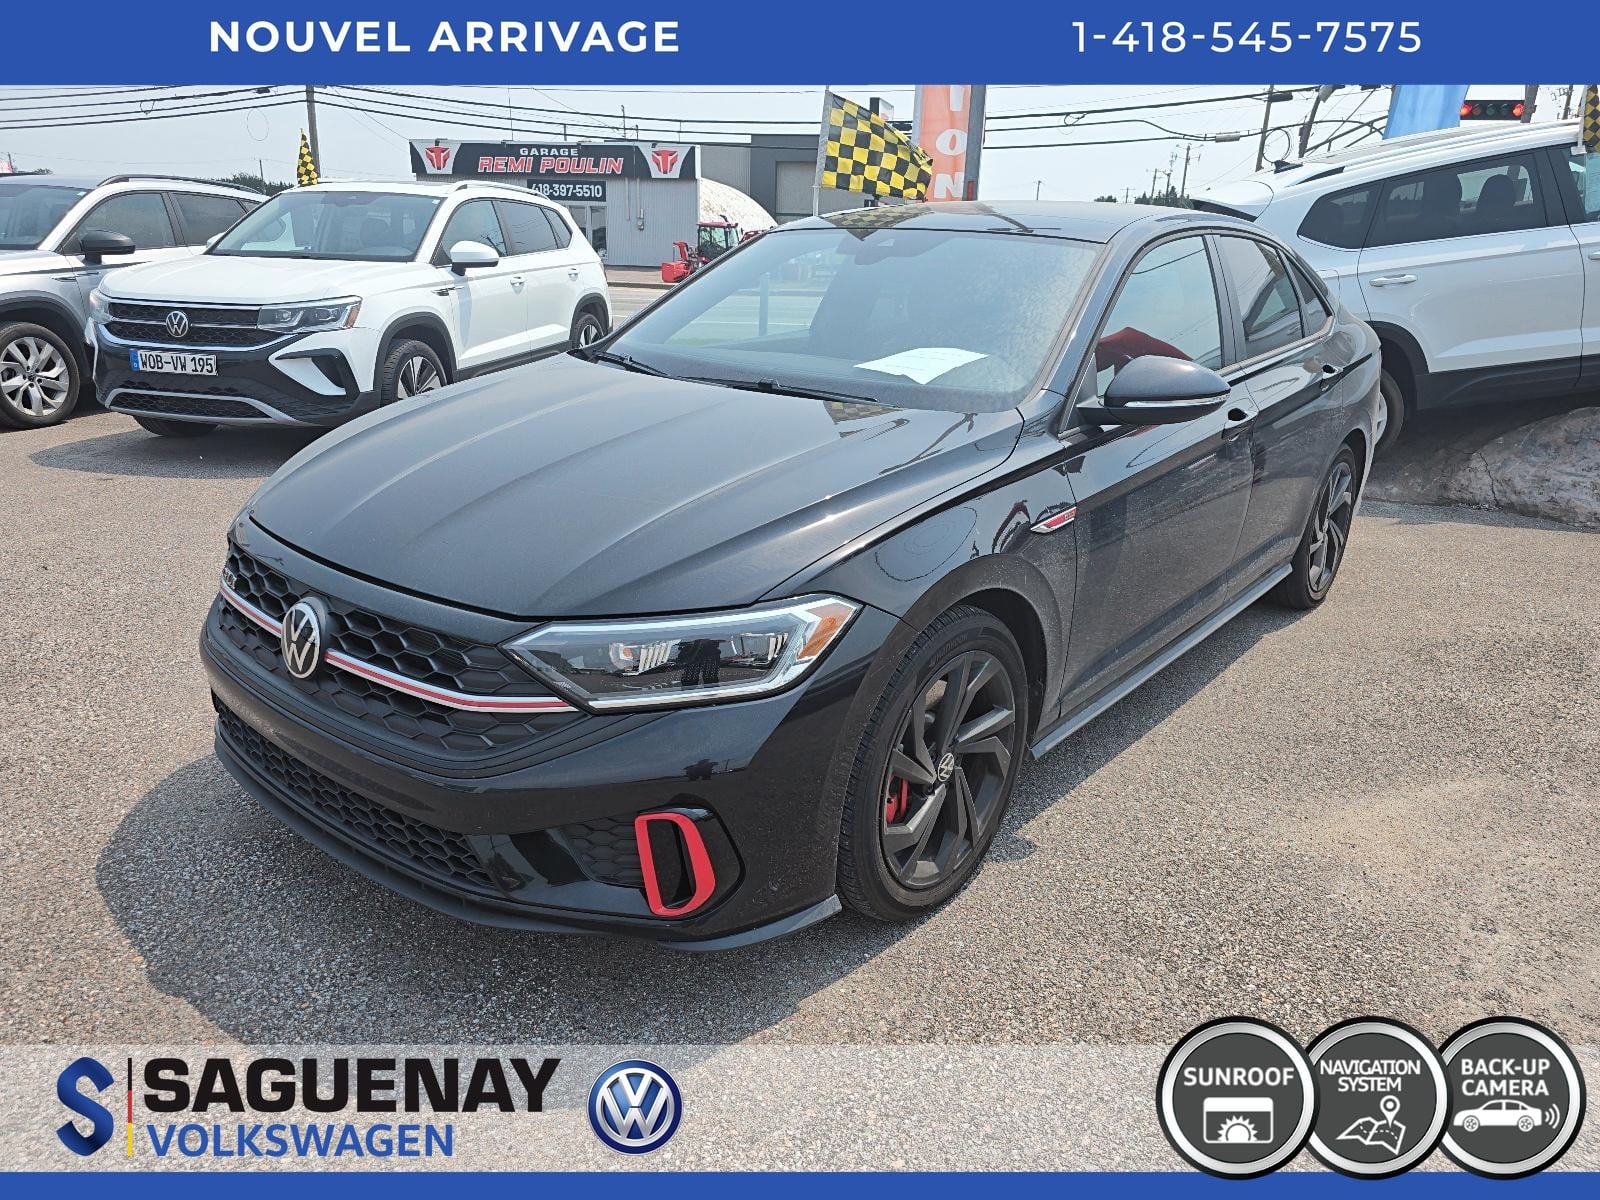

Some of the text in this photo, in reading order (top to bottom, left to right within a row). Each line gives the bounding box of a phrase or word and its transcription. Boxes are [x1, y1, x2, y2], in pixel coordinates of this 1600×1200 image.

[519, 147, 579, 156] GARAGE
[477, 156, 624, 175] REMI POULIN
[139, 352, 187, 372] WOB-VW
[190, 356, 214, 374] 195
